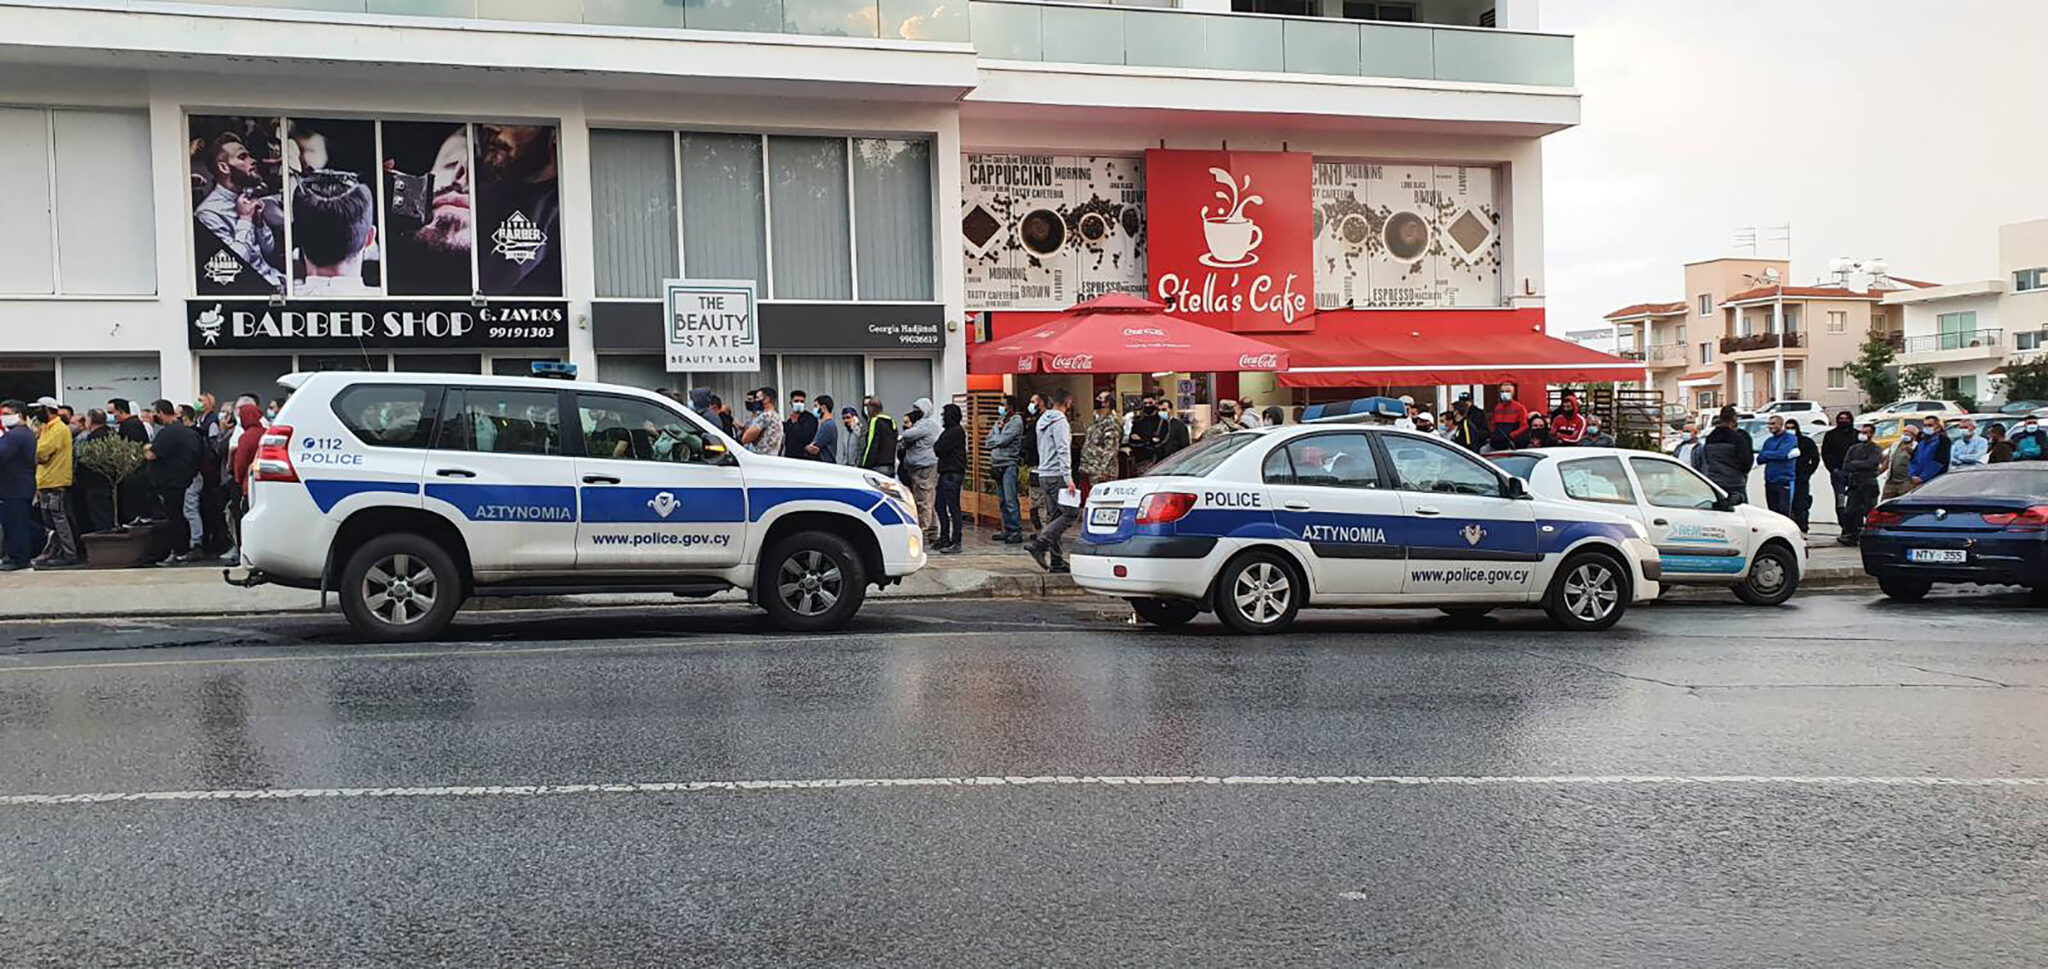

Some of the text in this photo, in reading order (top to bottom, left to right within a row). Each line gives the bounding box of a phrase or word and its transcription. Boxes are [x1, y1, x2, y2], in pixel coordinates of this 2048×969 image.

[1020, 155, 1054, 165] BREAKFAST
[970, 164, 1092, 187] CAPPUCCINO MORNING
[1012, 187, 1030, 198] TASTY
[1032, 189, 1064, 198] CAFETERIA
[499, 229, 541, 241] BARBER
[989, 267, 1026, 280] MORNING
[1021, 285, 1050, 298] BROWN
[1082, 281, 1121, 294] ESPRESSO
[967, 290, 986, 299] TASTY
[1158, 272, 1306, 324] Stella's Cafe
[1373, 288, 1414, 301] ESPRESSO
[698, 296, 724, 310] THE
[479, 308, 562, 322] G. ZAVROS
[232, 312, 474, 338] BARBER SHOP
[676, 313, 749, 331] BEAUTY
[489, 327, 555, 338] 99191303
[868, 324, 899, 335] Georgia
[686, 335, 739, 348] STATE
[671, 355, 755, 364] BEAUTY SALON
[318, 438, 342, 450] 112
[300, 452, 364, 465] POLICE
[1204, 492, 1261, 508] POLICE
[475, 505, 571, 519] ΑΣΤΥΝΟΜΙΑ
[592, 532, 731, 547] www.police.gov.cy
[1302, 525, 1386, 543] ΑΣΤΥΝΟΜΙΑ
[1915, 550, 1962, 560] NTY 355
[1411, 567, 1529, 585] www.police.gov.cy
